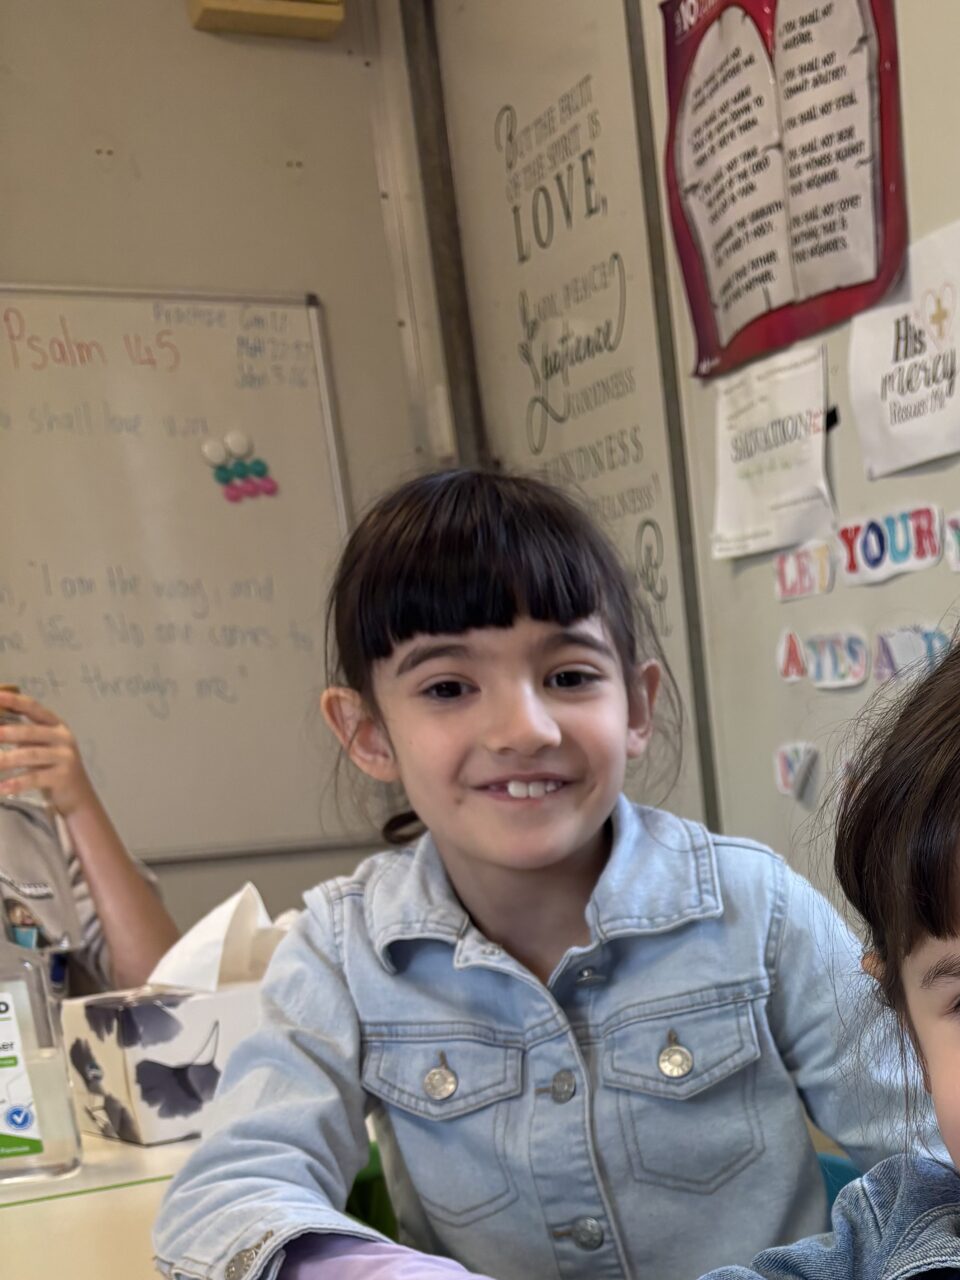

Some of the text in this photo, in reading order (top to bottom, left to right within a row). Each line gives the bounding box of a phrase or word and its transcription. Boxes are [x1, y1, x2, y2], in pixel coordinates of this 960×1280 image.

[3, 307, 181, 374] Psalm 145
[881, 348, 958, 402] mercy
[777, 543, 830, 598] LET
[838, 506, 940, 574] YOUR
